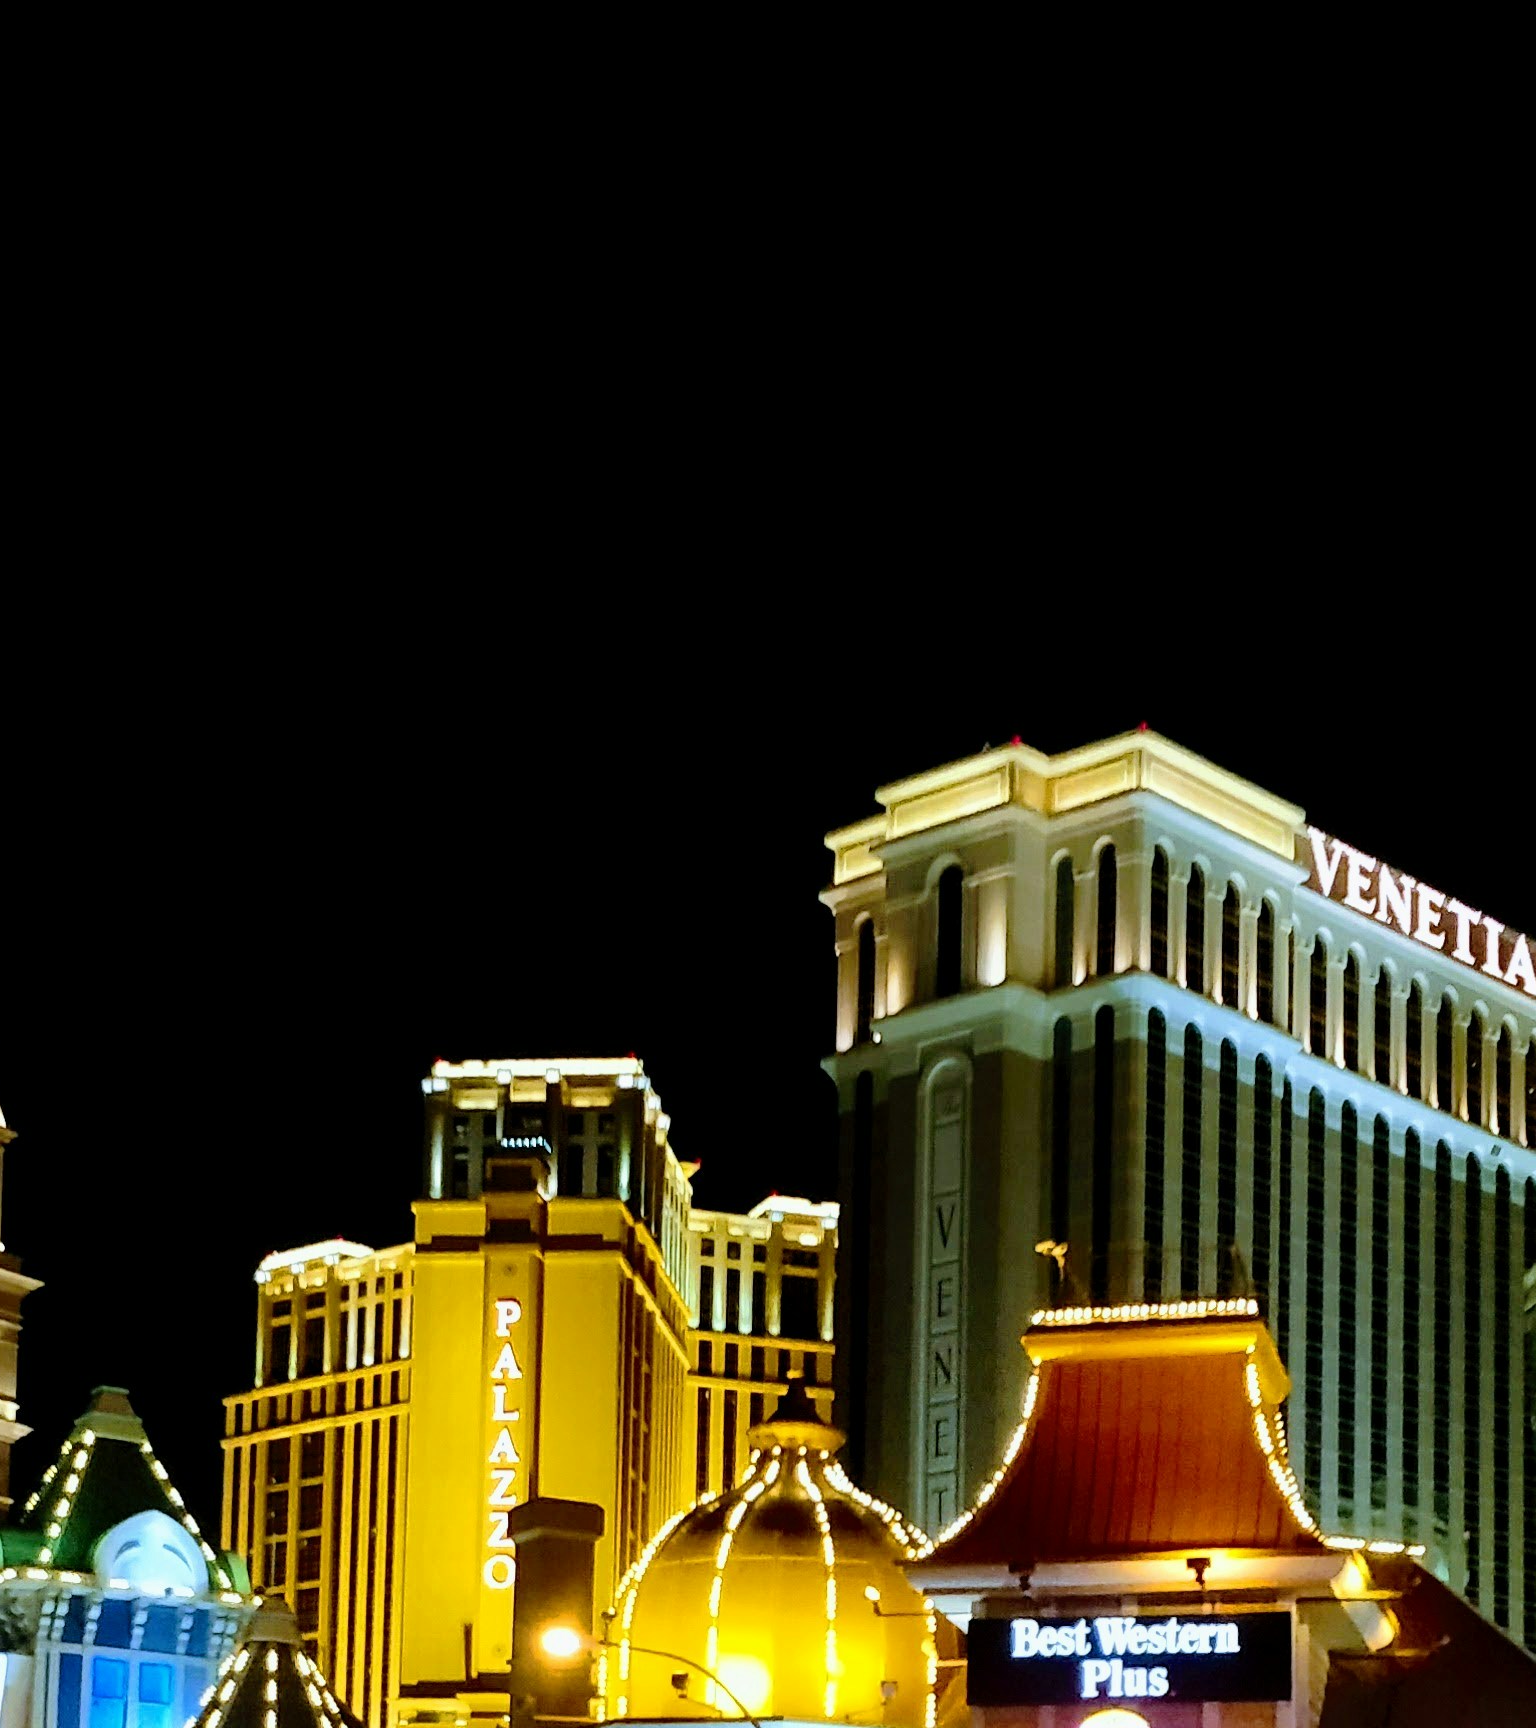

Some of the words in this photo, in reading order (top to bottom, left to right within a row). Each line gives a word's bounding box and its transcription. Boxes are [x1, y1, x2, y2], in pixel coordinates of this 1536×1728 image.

[482, 1297, 524, 1590] PALAZZO
[1011, 1618, 1092, 1658] Best
[1093, 1617, 1241, 1654] Western
[1080, 1658, 1170, 1698] Plus
